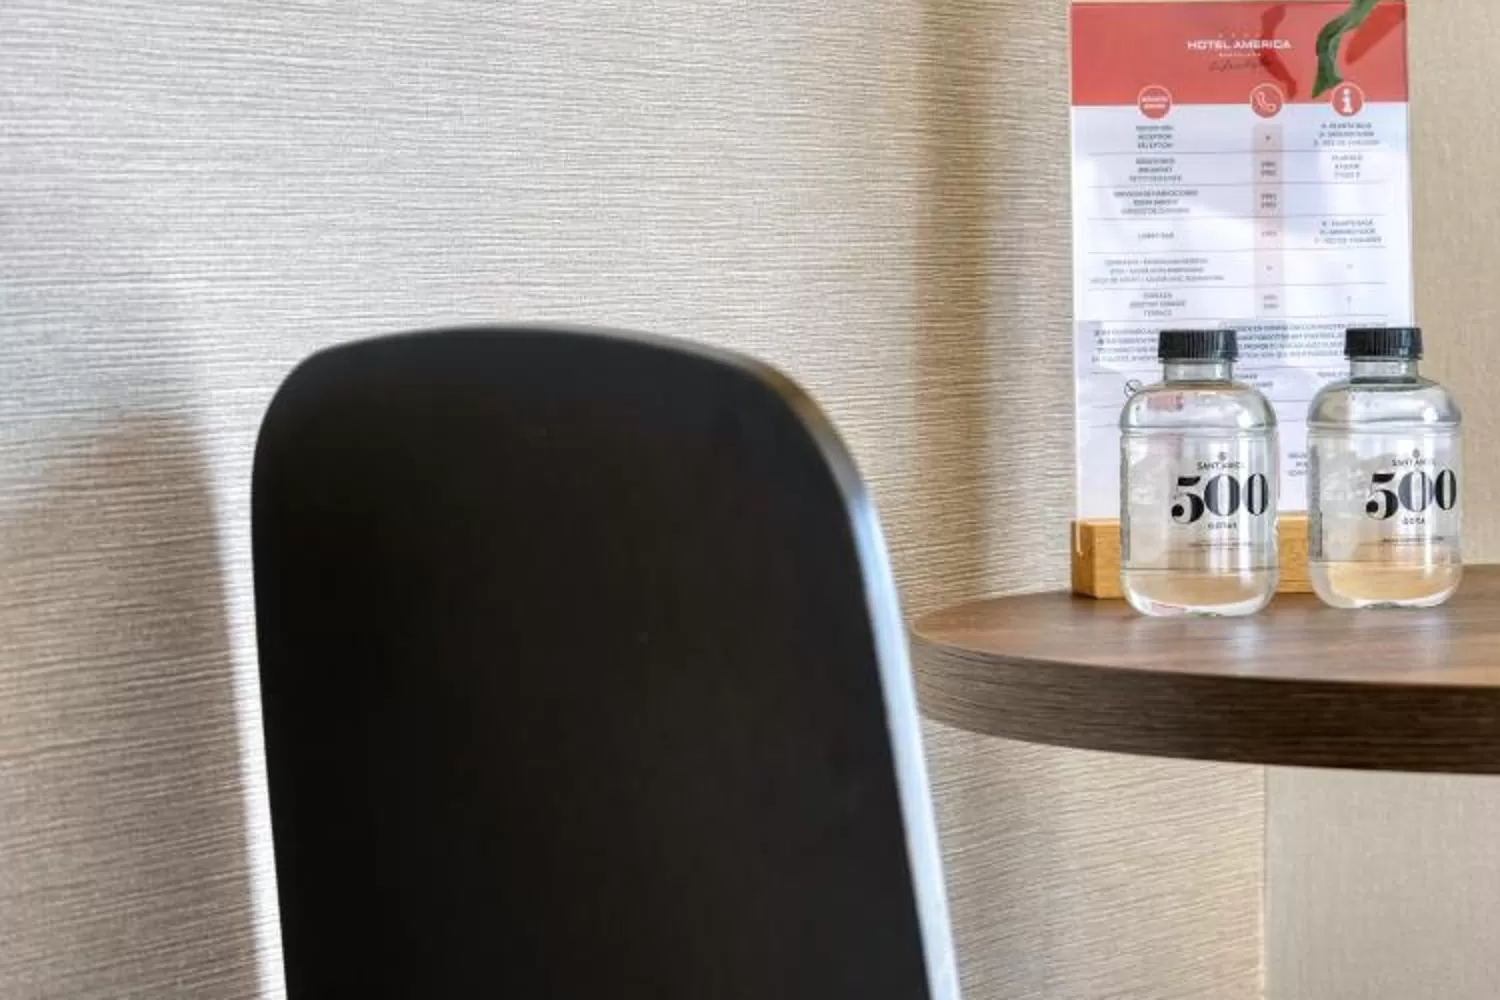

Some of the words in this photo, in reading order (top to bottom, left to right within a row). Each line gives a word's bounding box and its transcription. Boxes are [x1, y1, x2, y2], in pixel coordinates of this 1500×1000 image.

[1187, 39, 1232, 49] HOTEL
[1232, 39, 1292, 49] AMERICA
[1171, 473, 1269, 524] 500
[1366, 469, 1457, 521] 500
